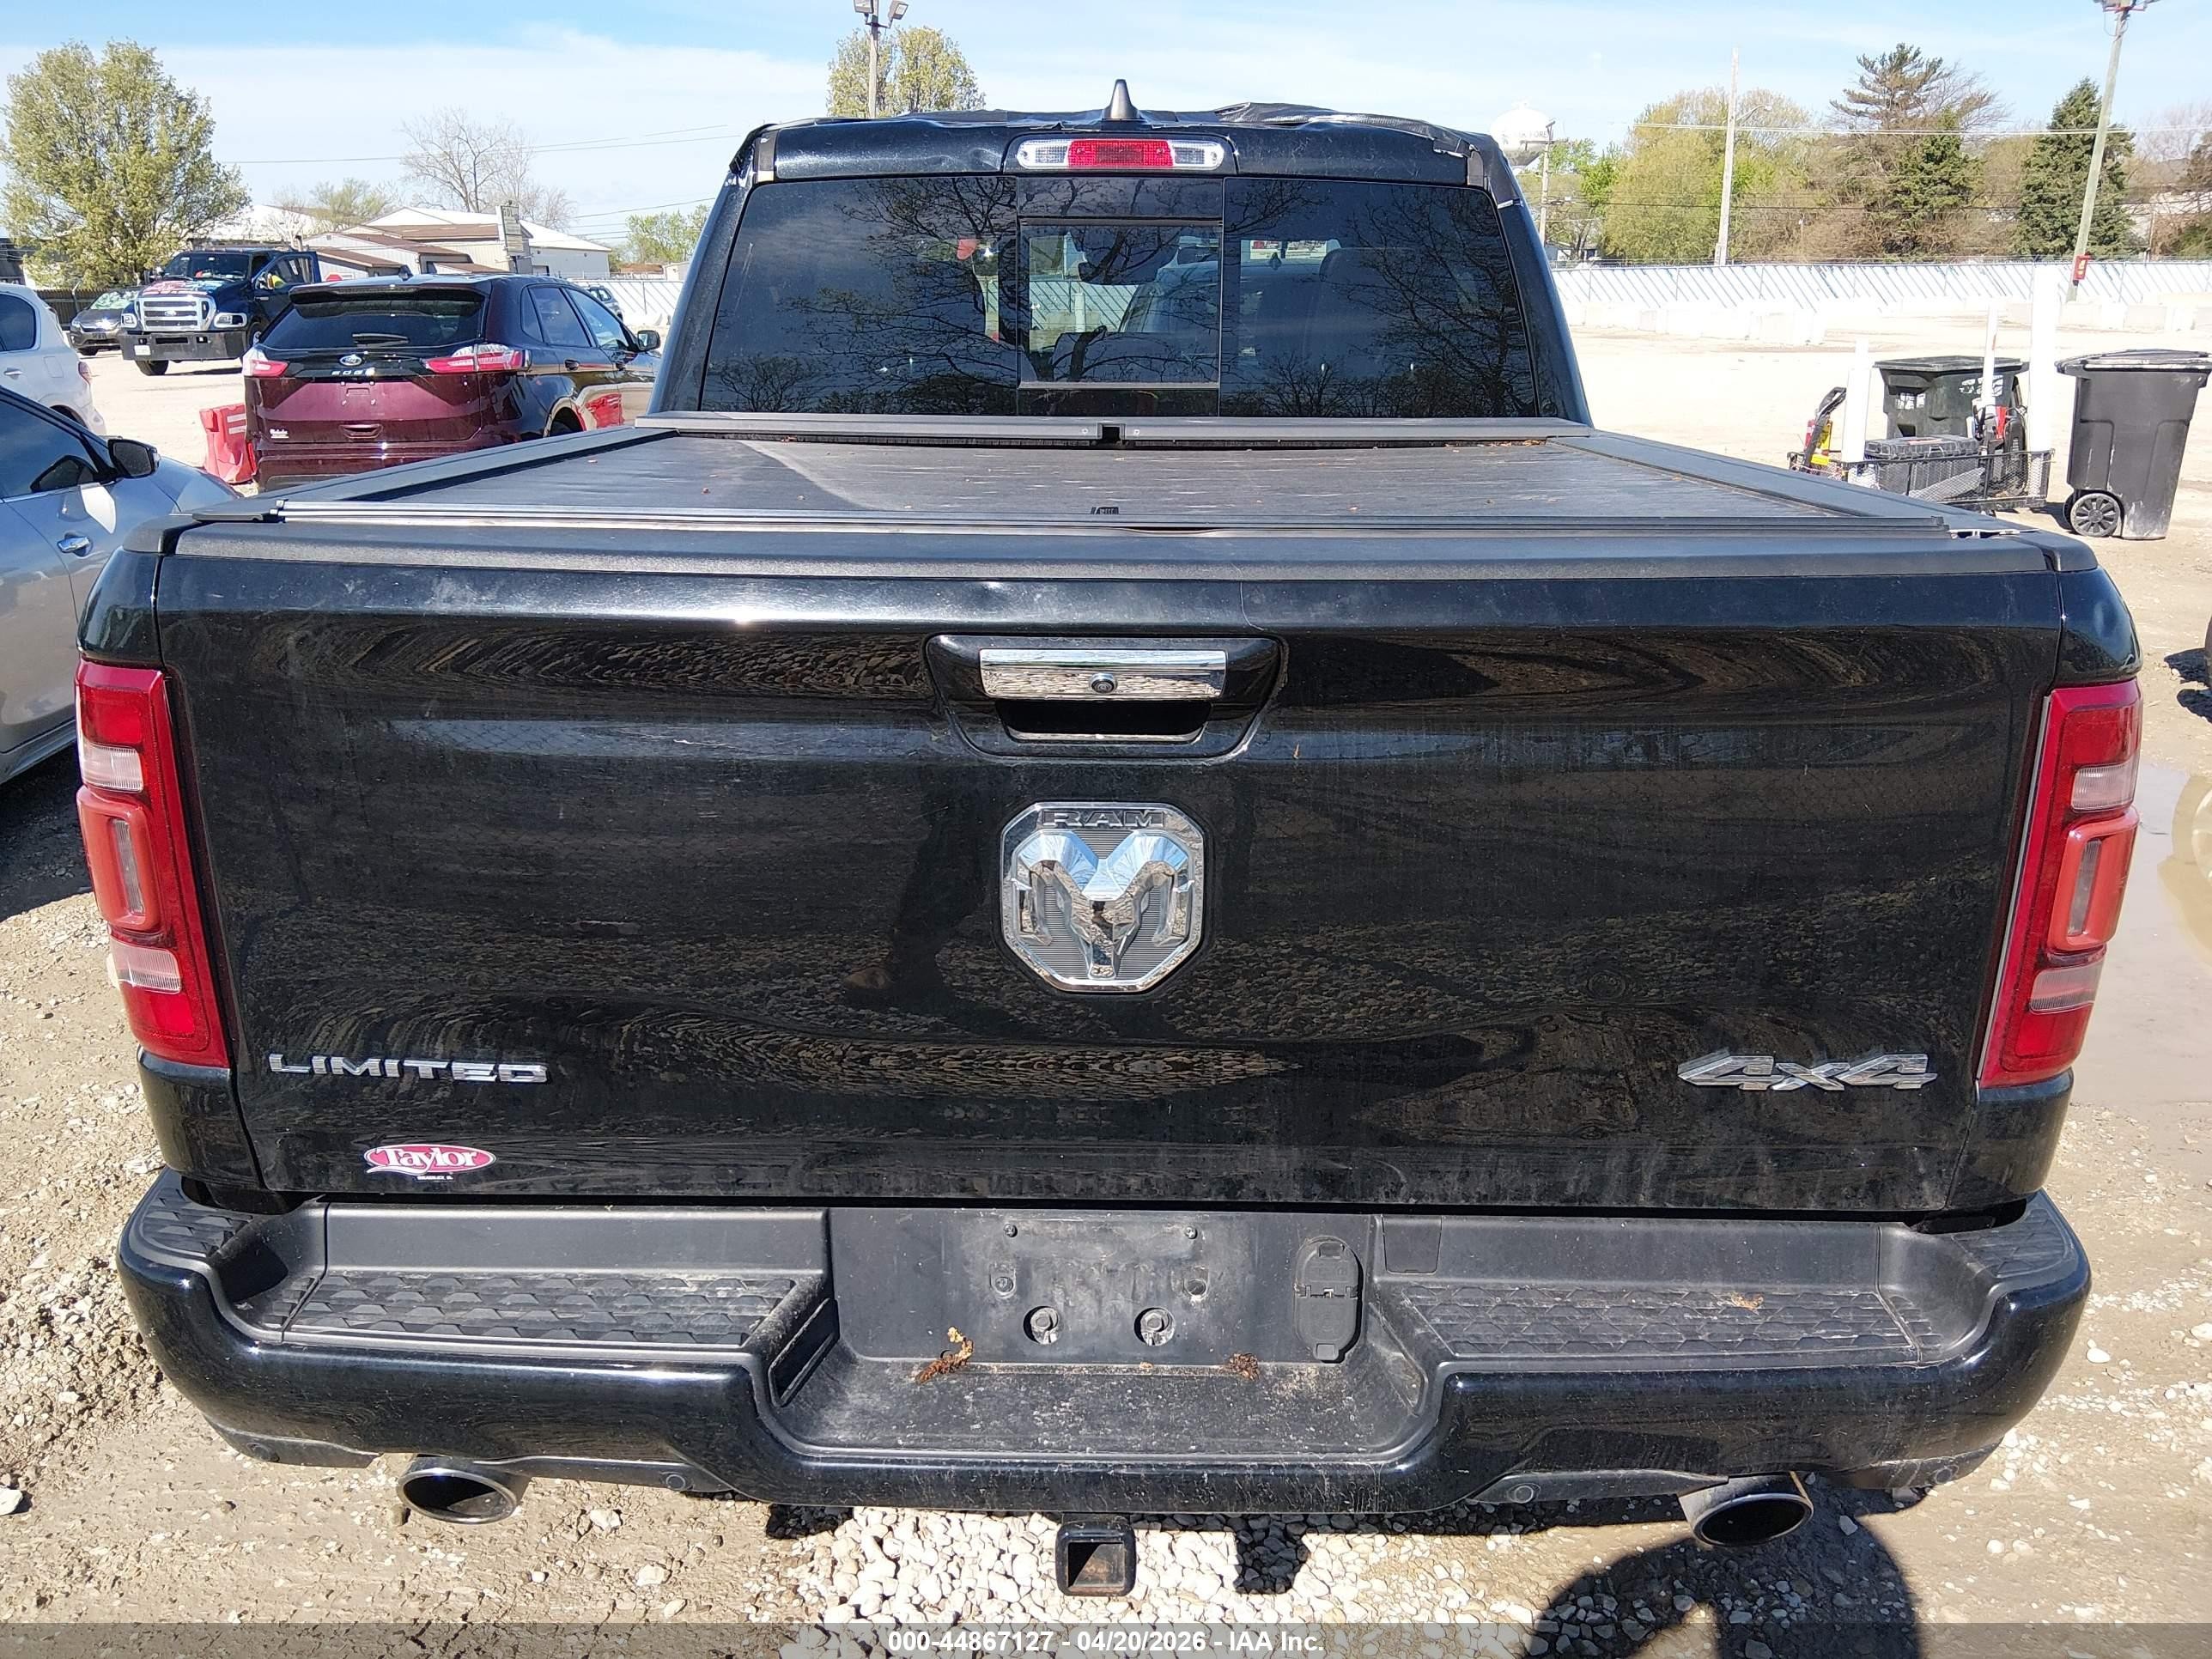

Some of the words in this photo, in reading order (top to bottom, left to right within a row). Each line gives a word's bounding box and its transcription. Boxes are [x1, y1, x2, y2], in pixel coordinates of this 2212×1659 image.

[1041, 810, 1165, 827] RAM
[269, 1053, 548, 1083] LIMITED
[371, 1147, 477, 1174] Taylor
